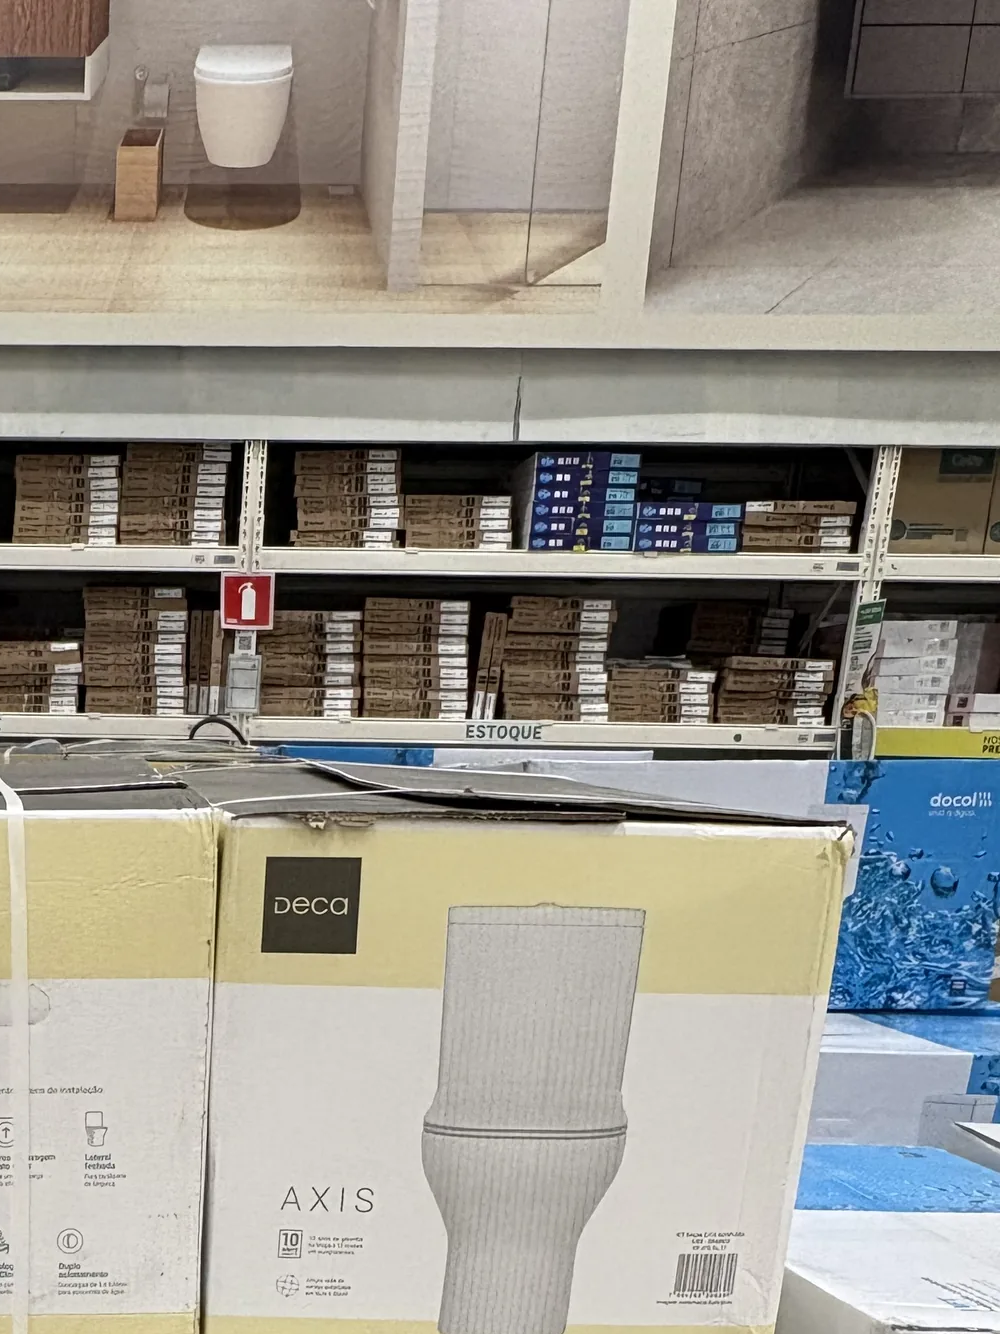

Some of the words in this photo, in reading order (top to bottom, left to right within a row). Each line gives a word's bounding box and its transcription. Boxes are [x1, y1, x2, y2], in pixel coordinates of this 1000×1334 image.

[466, 724, 542, 741] ESTOQUE
[984, 736, 1000, 744] NO
[930, 792, 977, 807] docol
[274, 895, 349, 916] Deca
[280, 1186, 375, 1213] AXIS
[282, 1232, 299, 1247] 10
